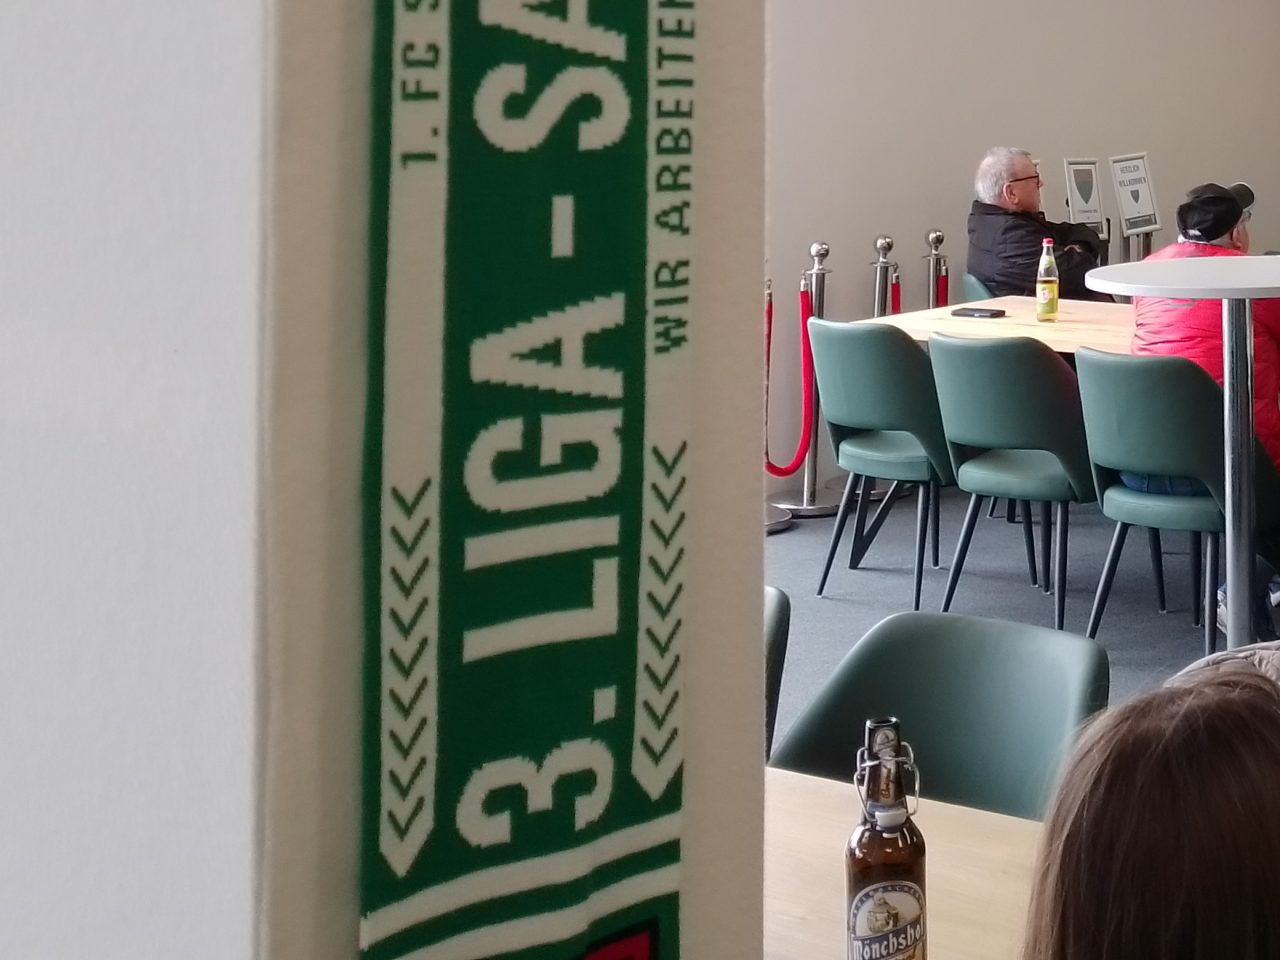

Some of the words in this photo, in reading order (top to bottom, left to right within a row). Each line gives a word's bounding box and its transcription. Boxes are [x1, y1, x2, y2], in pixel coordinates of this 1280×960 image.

[400, 42, 442, 104] FC
[400, 125, 440, 168] 1.
[653, 257, 691, 355] WIR
[462, 292, 627, 664] LIGA
[456, 685, 619, 848] 3.
